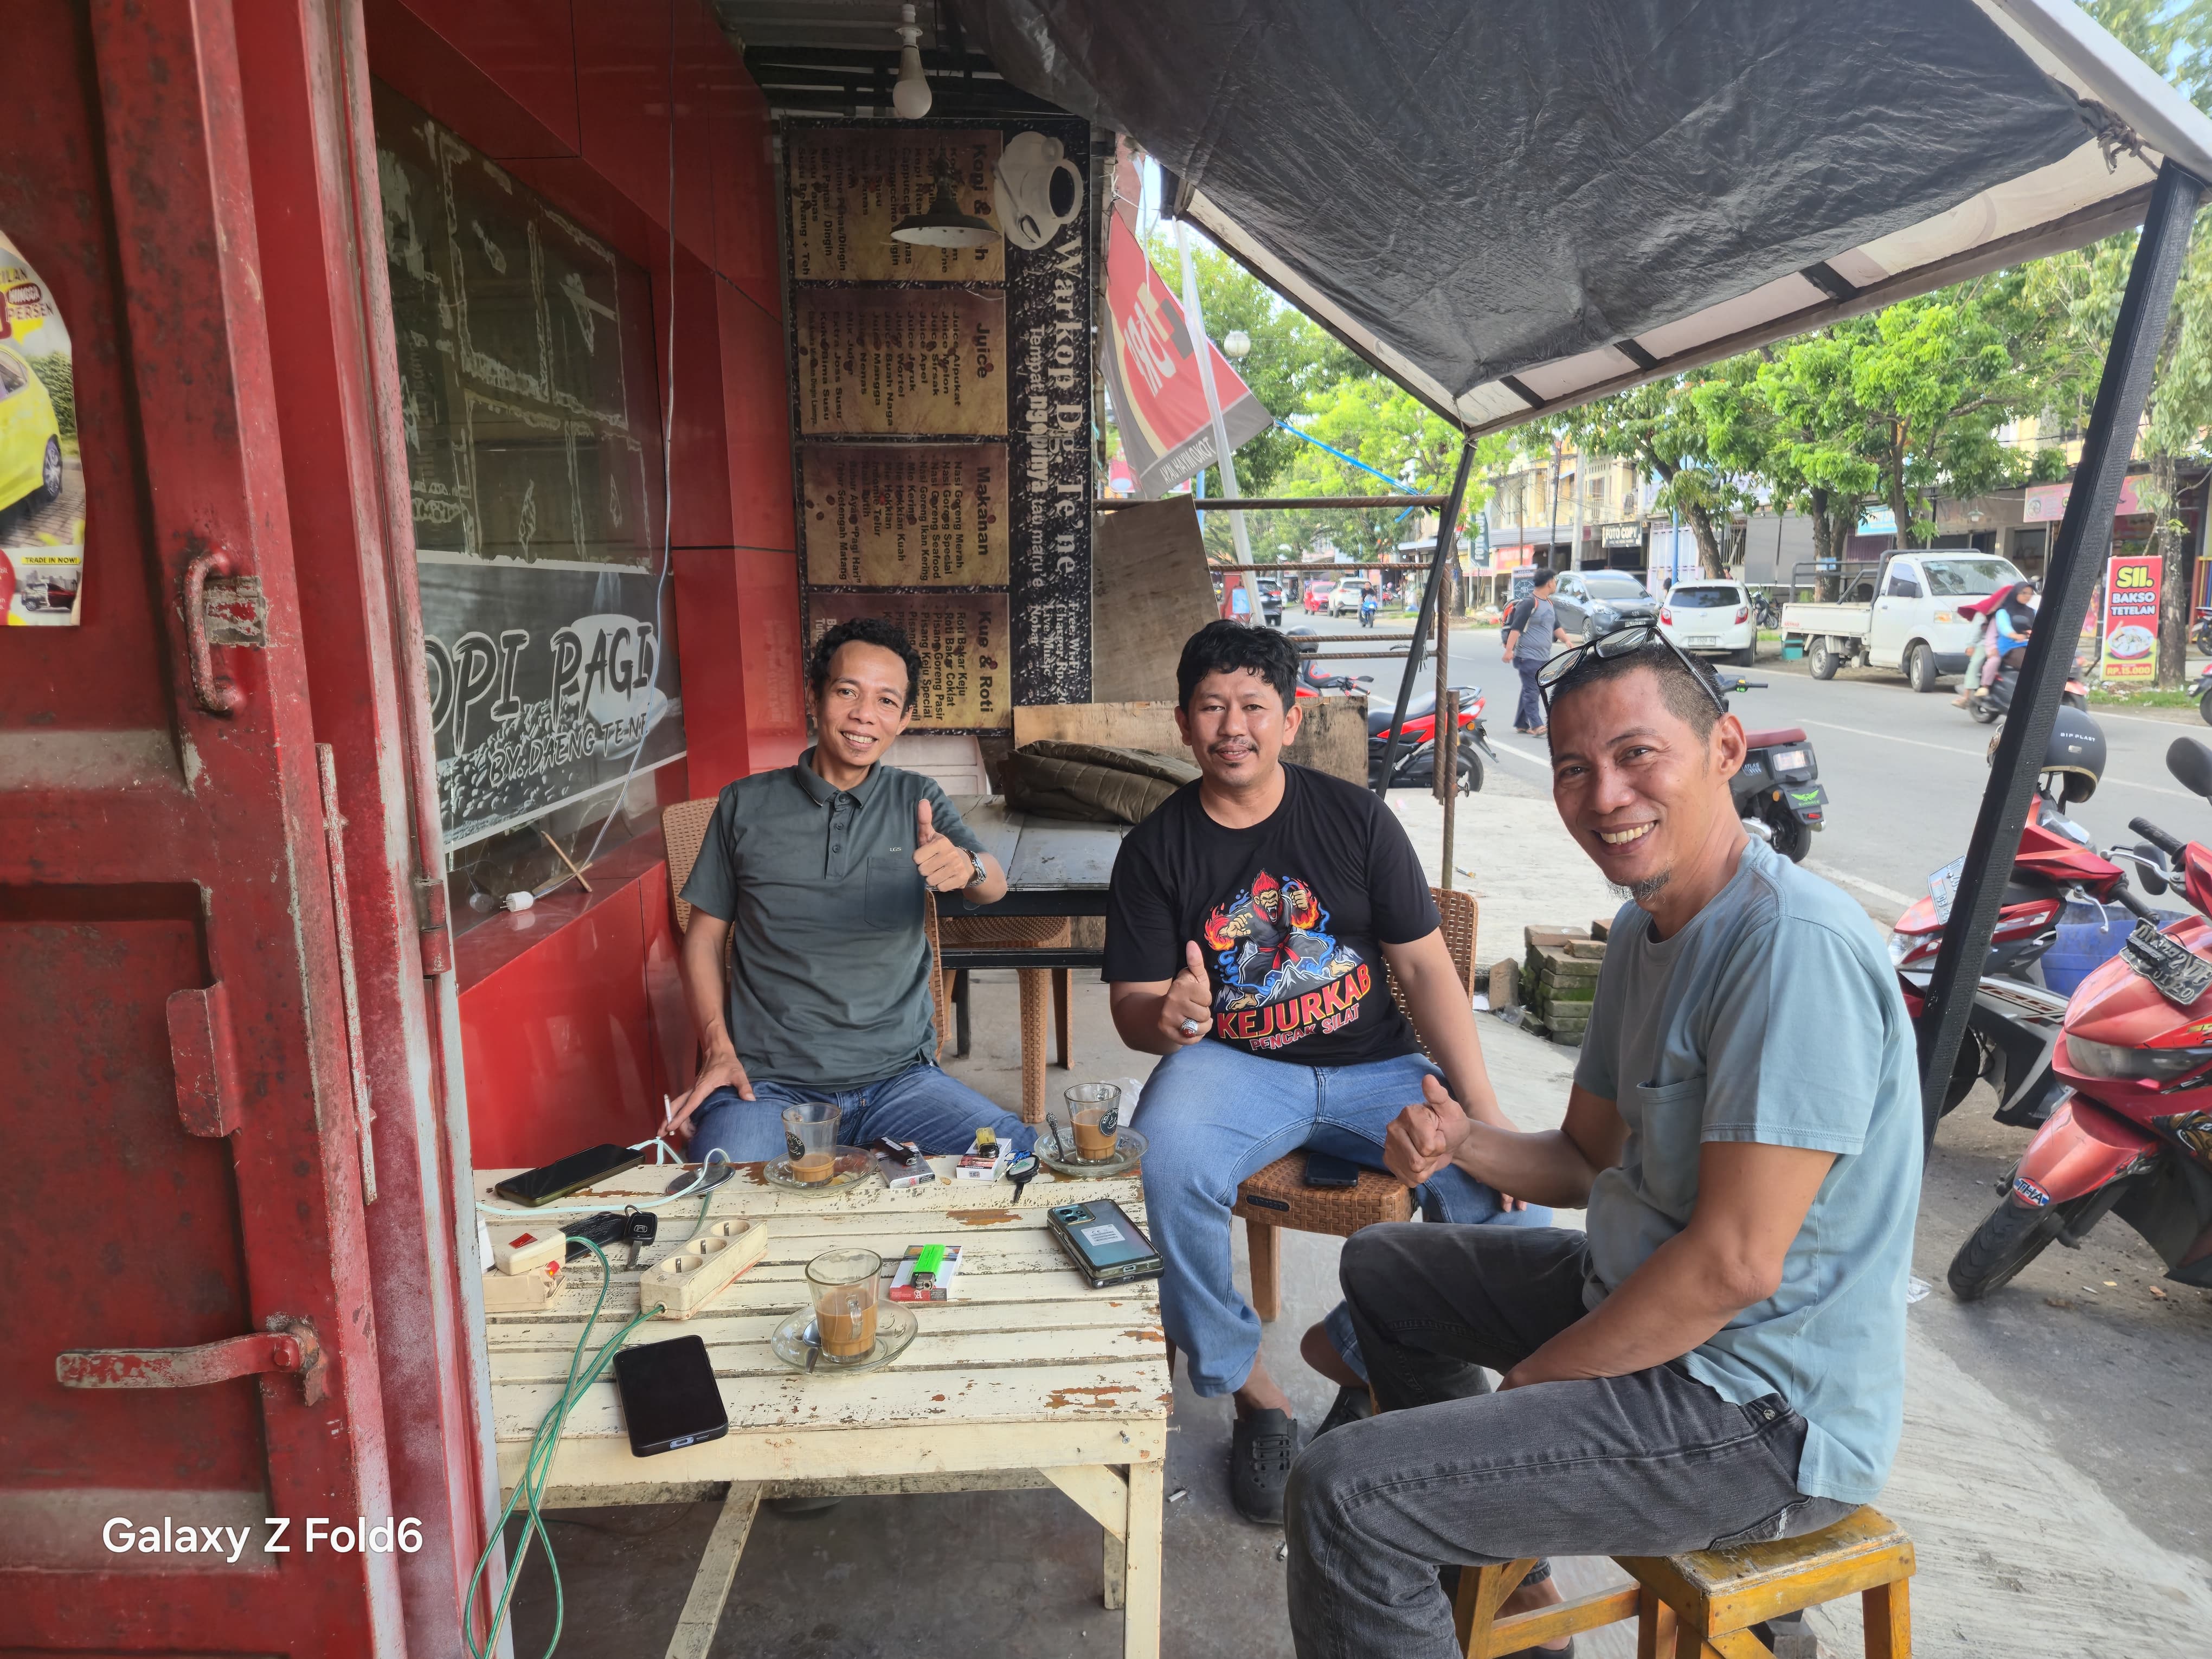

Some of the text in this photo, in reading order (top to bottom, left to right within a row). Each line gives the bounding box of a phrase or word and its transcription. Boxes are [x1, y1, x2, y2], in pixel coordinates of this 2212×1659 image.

[822, 221, 832, 256] Dingin
[801, 253, 809, 275] Teh
[7, 303, 54, 321] PERSEN
[1047, 236, 1082, 390] Warkop
[918, 353, 927, 384] Apel
[975, 323, 989, 378] Juice
[1028, 324, 1044, 391] Tempat
[872, 353, 880, 406] Mangga
[896, 353, 904, 397] Wortel
[953, 353, 961, 407] Alpukat
[834, 388, 843, 419] Susu
[885, 393, 893, 426] Naga
[1025, 396, 1047, 492] ngopinya
[1048, 403, 1083, 463] Dg.
[837, 490, 846, 538] Setengah
[873, 509, 881, 537] Telur
[884, 485, 892, 529] Hokkian
[895, 485, 903, 530] Hokkian
[918, 462, 929, 581] Nasi Goreng Ikan Kering
[941, 490, 950, 530] Goreng
[953, 461, 963, 568] Nasi Goreng Merah
[976, 467, 990, 555] Makanan
[1030, 499, 1044, 524] tau
[942, 534, 951, 574] Special
[1605, 526, 1638, 540] FOTO COPY
[838, 542, 847, 580] Matang
[931, 535, 940, 578] Seafood
[1068, 602, 1078, 632] Free
[2111, 606, 2156, 616] TETELAN
[2112, 591, 2156, 604] BAKSO
[1030, 605, 1040, 646] Nobar
[1043, 605, 1053, 676] Live Music
[1054, 604, 1066, 657] Charger
[919, 612, 931, 718] Pisang Keju Special
[933, 653, 943, 691] Goreng
[944, 613, 955, 706] Roti Bakar Coklat
[956, 612, 967, 696] Roti Bakar Keju
[978, 612, 992, 712] Kue & Roti
[425, 622, 659, 756] OPI PAGI
[935, 694, 944, 721] Pasir
[529, 723, 595, 776] DAENG
[1217, 963, 1371, 1039] KEJURKAB
[1249, 1002, 1360, 1050] PENCAK SILAT
